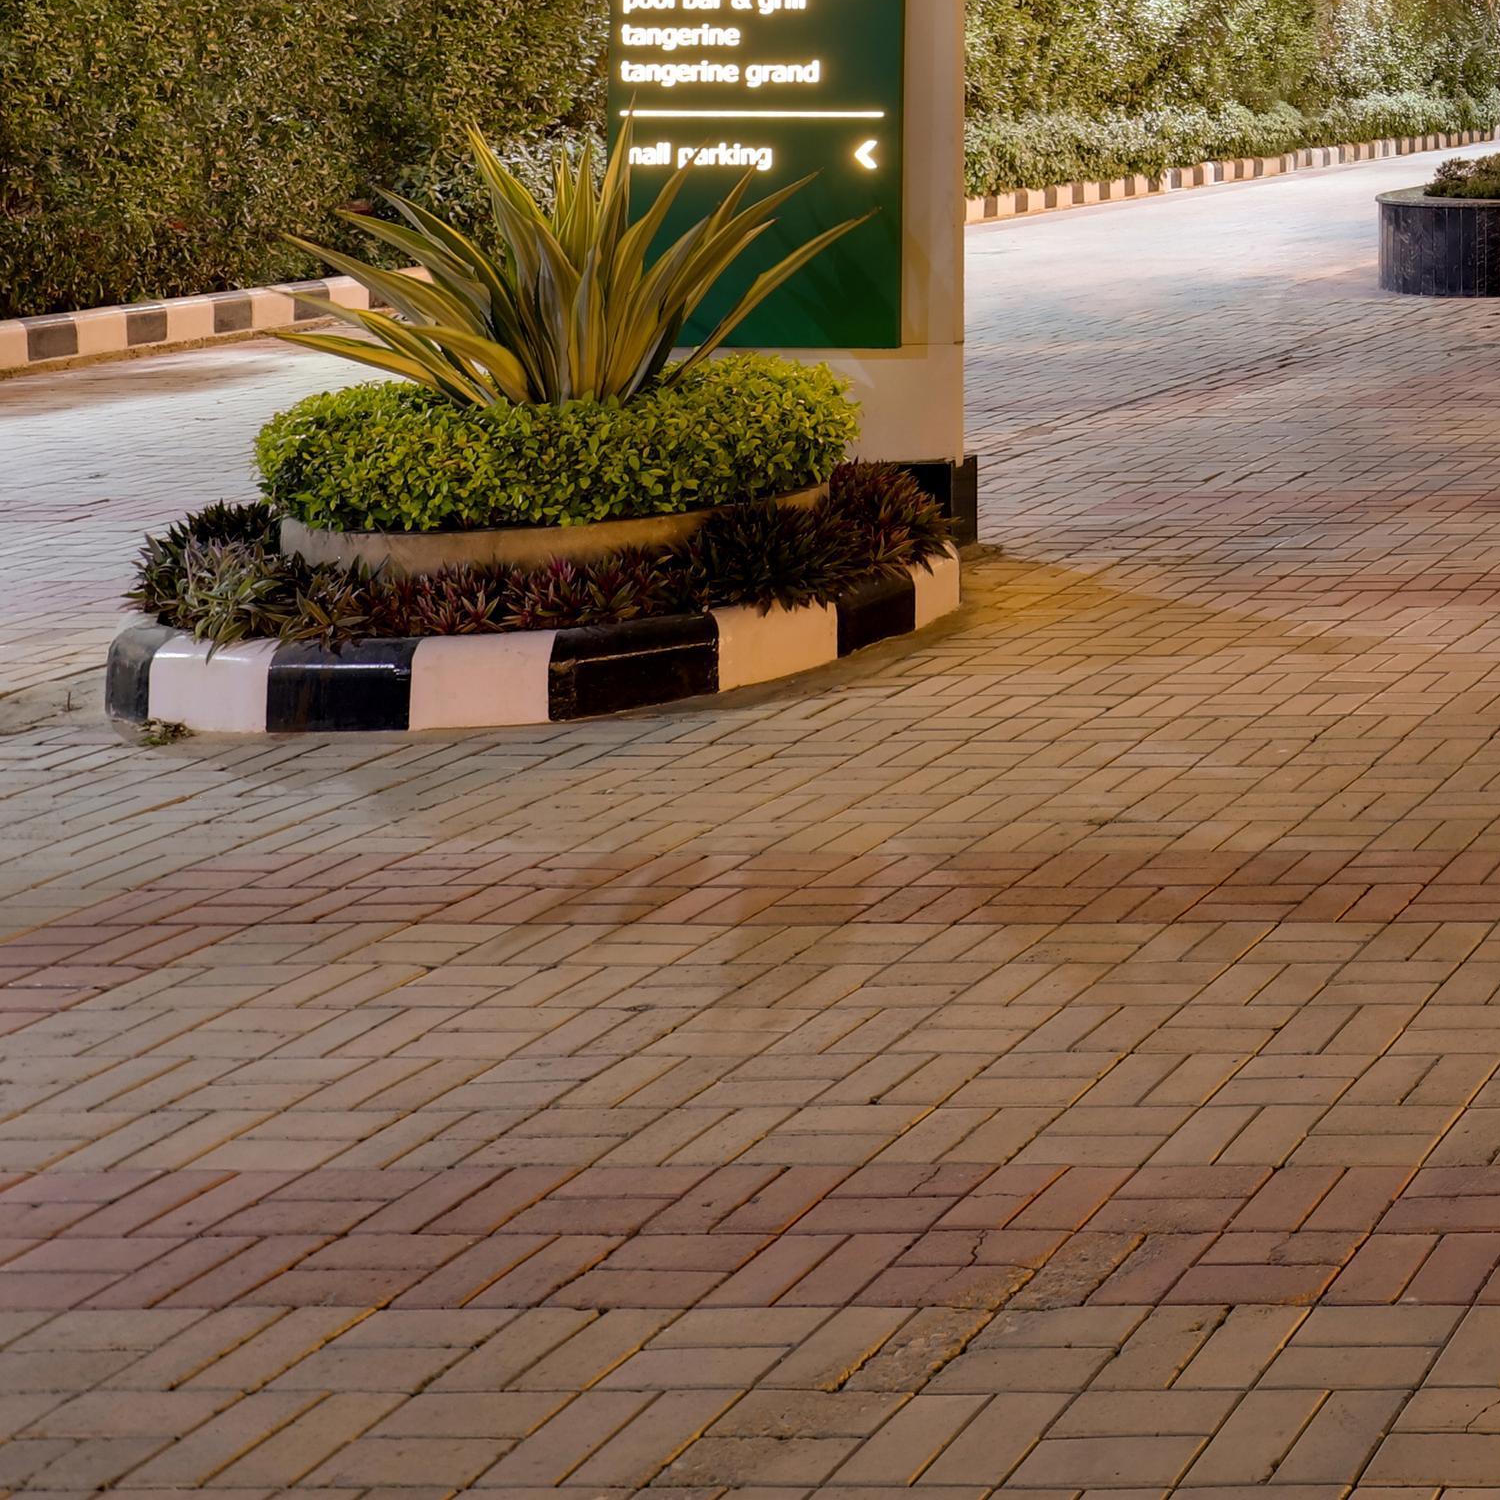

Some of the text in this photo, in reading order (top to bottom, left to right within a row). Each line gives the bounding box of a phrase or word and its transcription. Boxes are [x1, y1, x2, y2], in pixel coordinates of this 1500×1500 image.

[621, 24, 741, 50] tangerine
[620, 60, 820, 87] tangerine grand
[677, 142, 773, 171] parking
